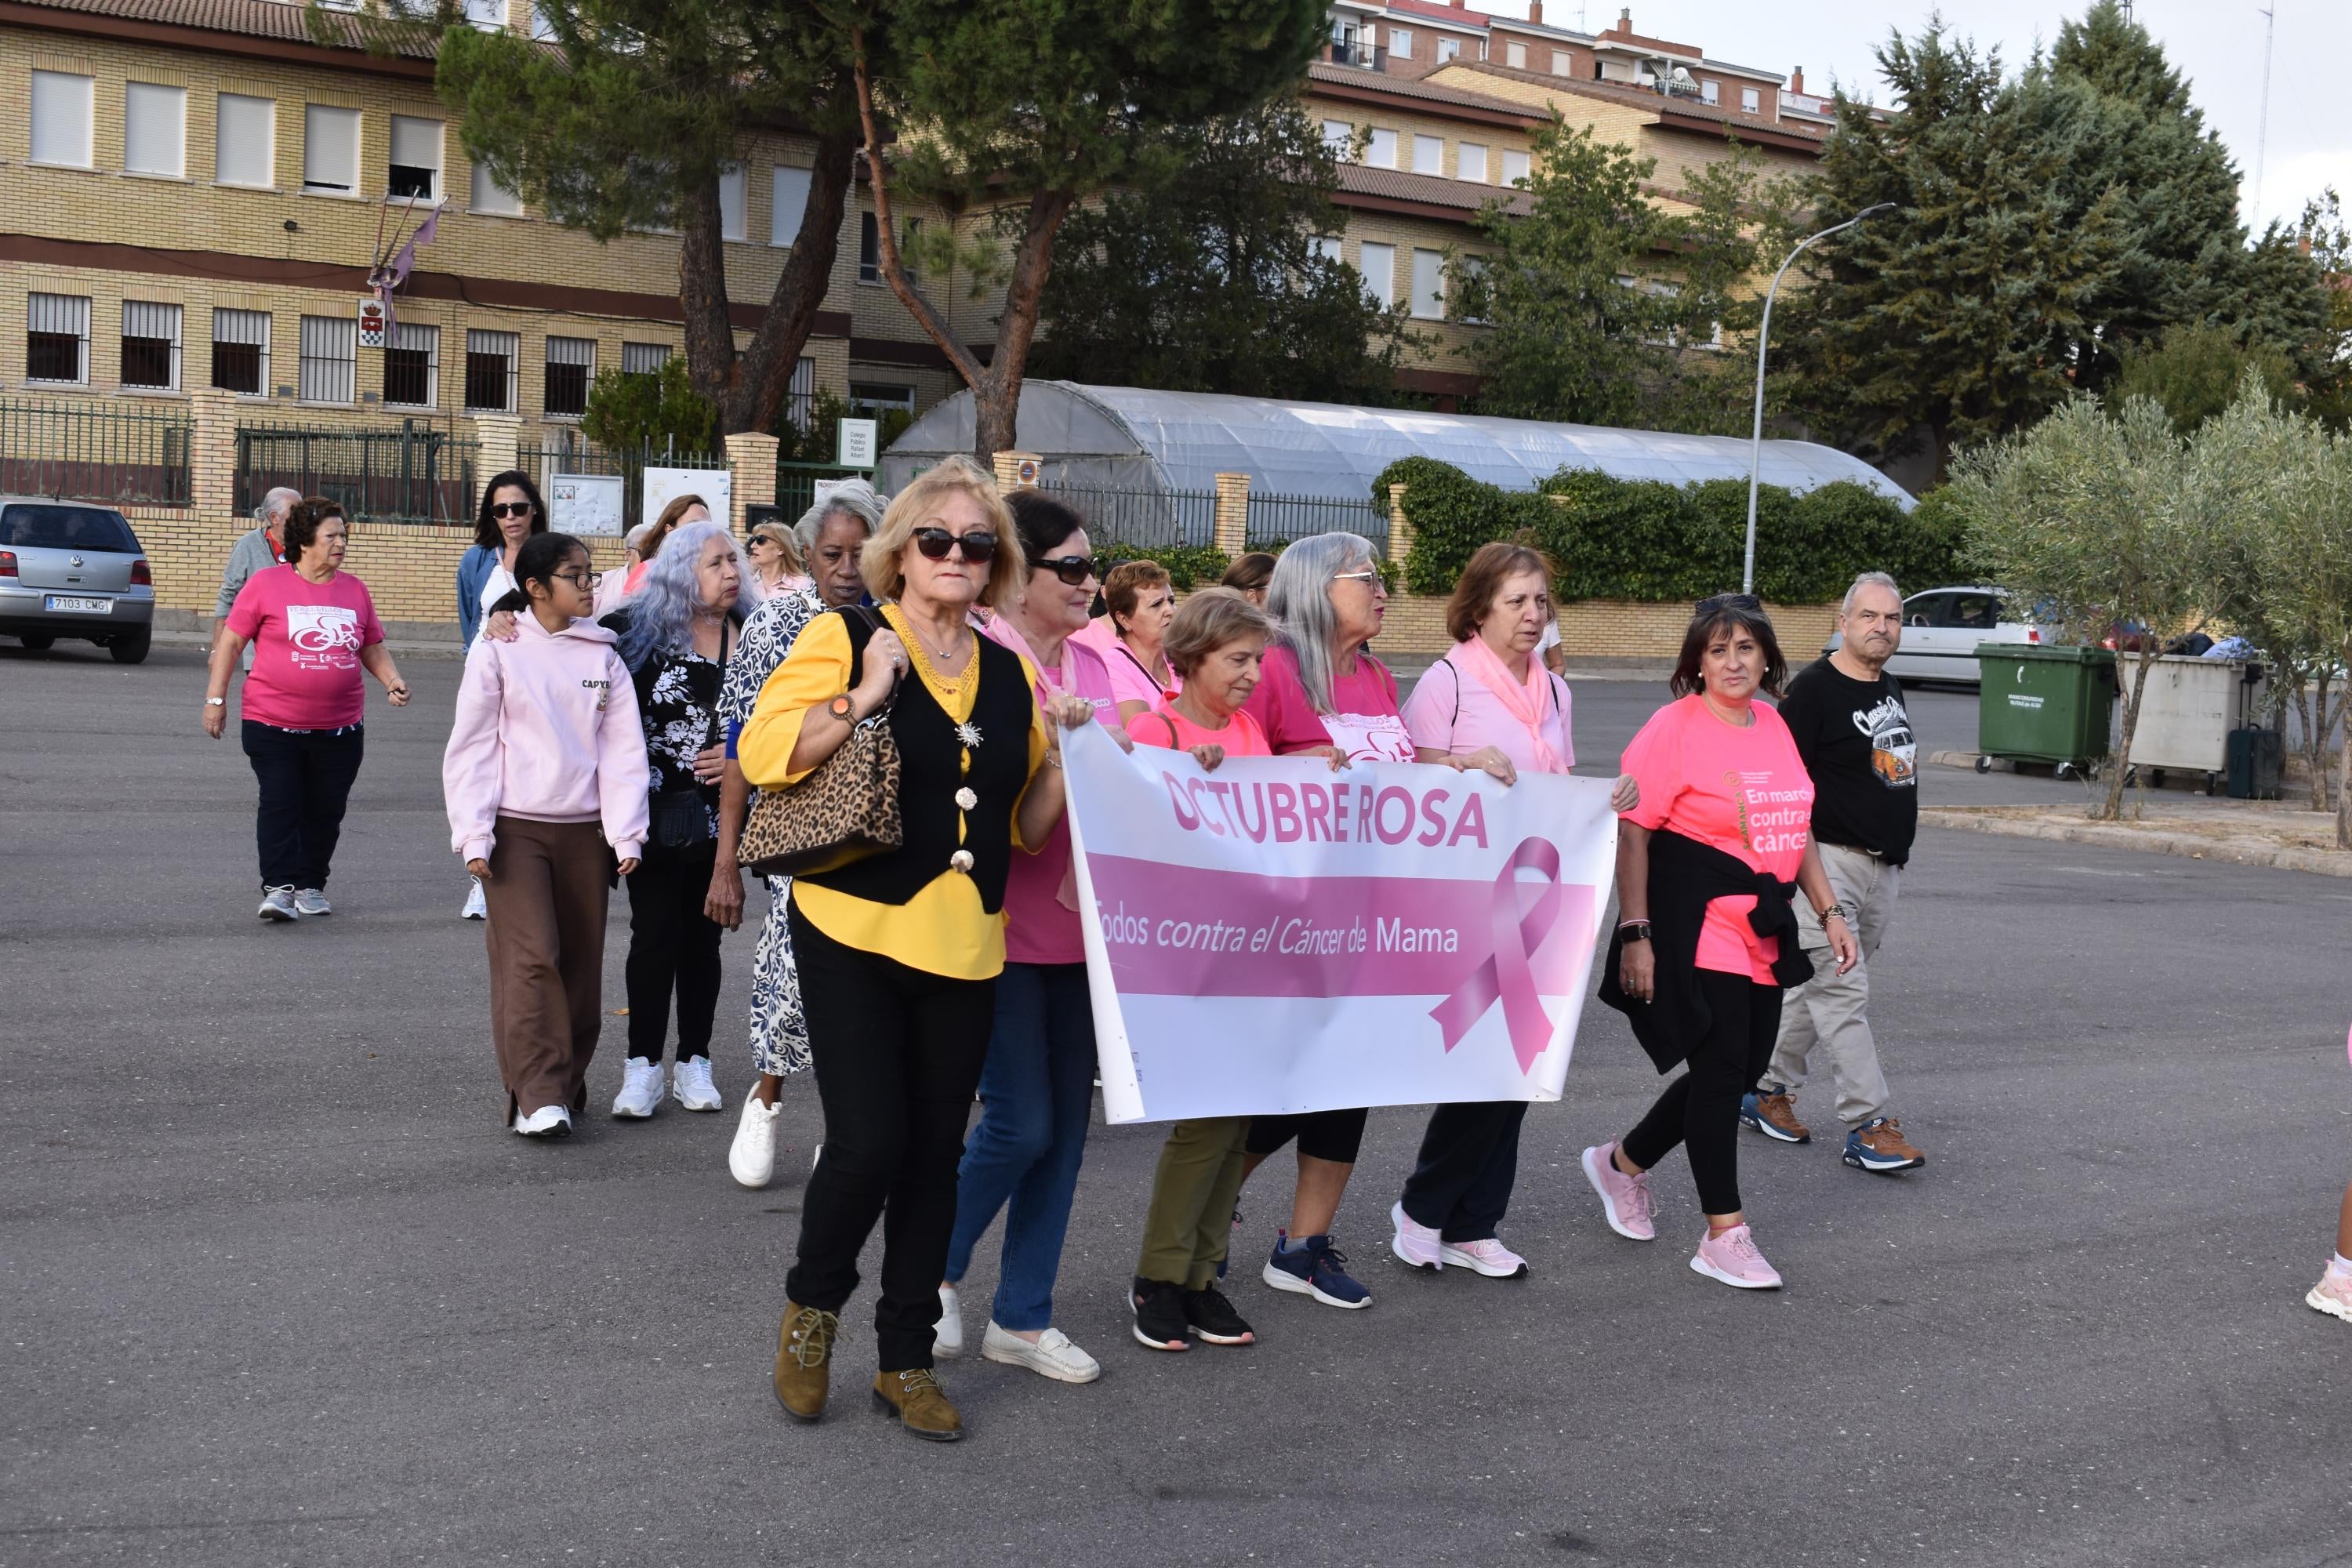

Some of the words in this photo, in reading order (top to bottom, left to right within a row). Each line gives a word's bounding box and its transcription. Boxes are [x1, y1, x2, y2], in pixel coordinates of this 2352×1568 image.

[56, 598, 80, 608] 7103
[85, 600, 104, 610] CMG
[1745, 789, 1769, 804] En
[1162, 770, 1349, 844] OCTUBRE
[1357, 784, 1489, 849] ROSA
[1750, 807, 1805, 827] contra
[1096, 900, 1149, 945] odos
[1156, 918, 1245, 953] contra
[1250, 916, 1279, 953] el
[1279, 918, 1345, 954] Cáncer
[1348, 915, 1367, 953] de
[1376, 916, 1458, 953] Mama
